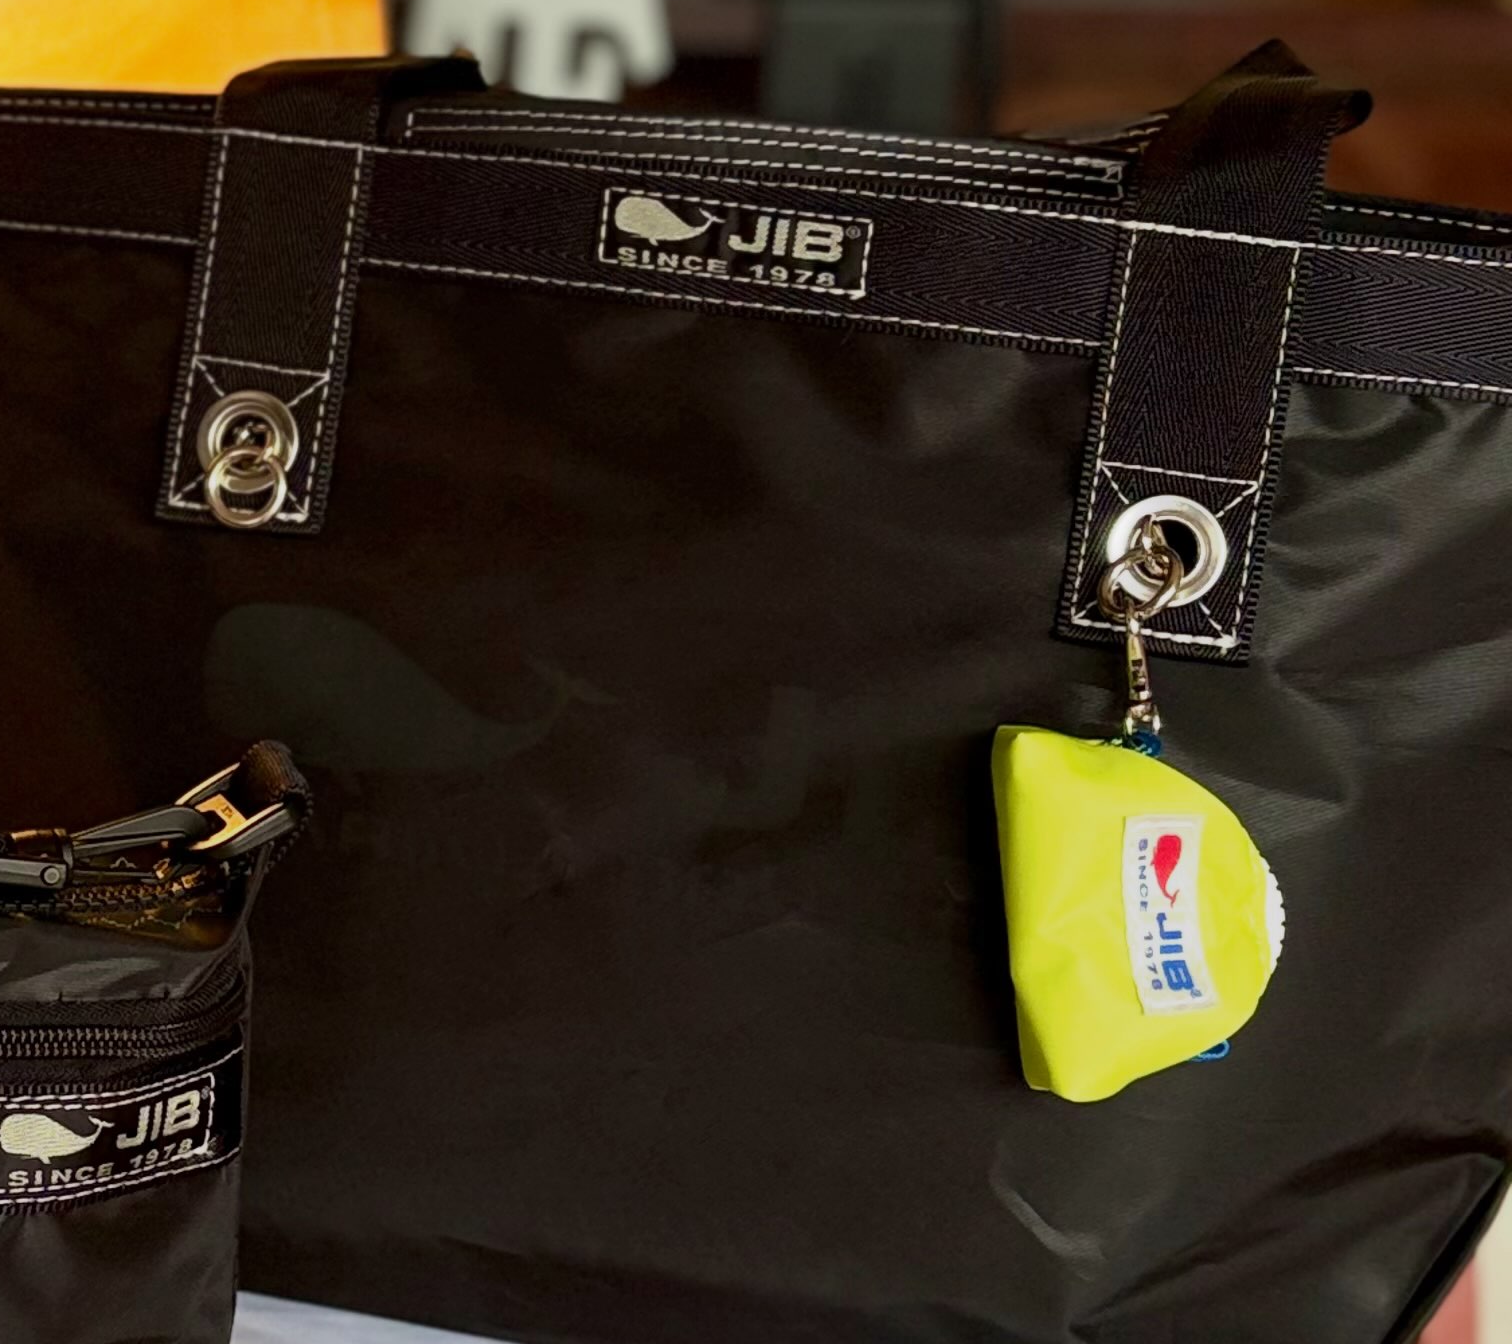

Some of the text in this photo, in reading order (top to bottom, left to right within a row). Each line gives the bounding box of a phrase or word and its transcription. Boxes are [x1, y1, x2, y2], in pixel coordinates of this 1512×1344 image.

[617, 246, 835, 287] SINCE 1978
[728, 216, 844, 262] JIB
[1138, 838, 1149, 912] SINCE
[1156, 912, 1194, 991] JIB
[116, 1089, 200, 1149] JIB
[8, 1138, 193, 1188] SINCE 1978
